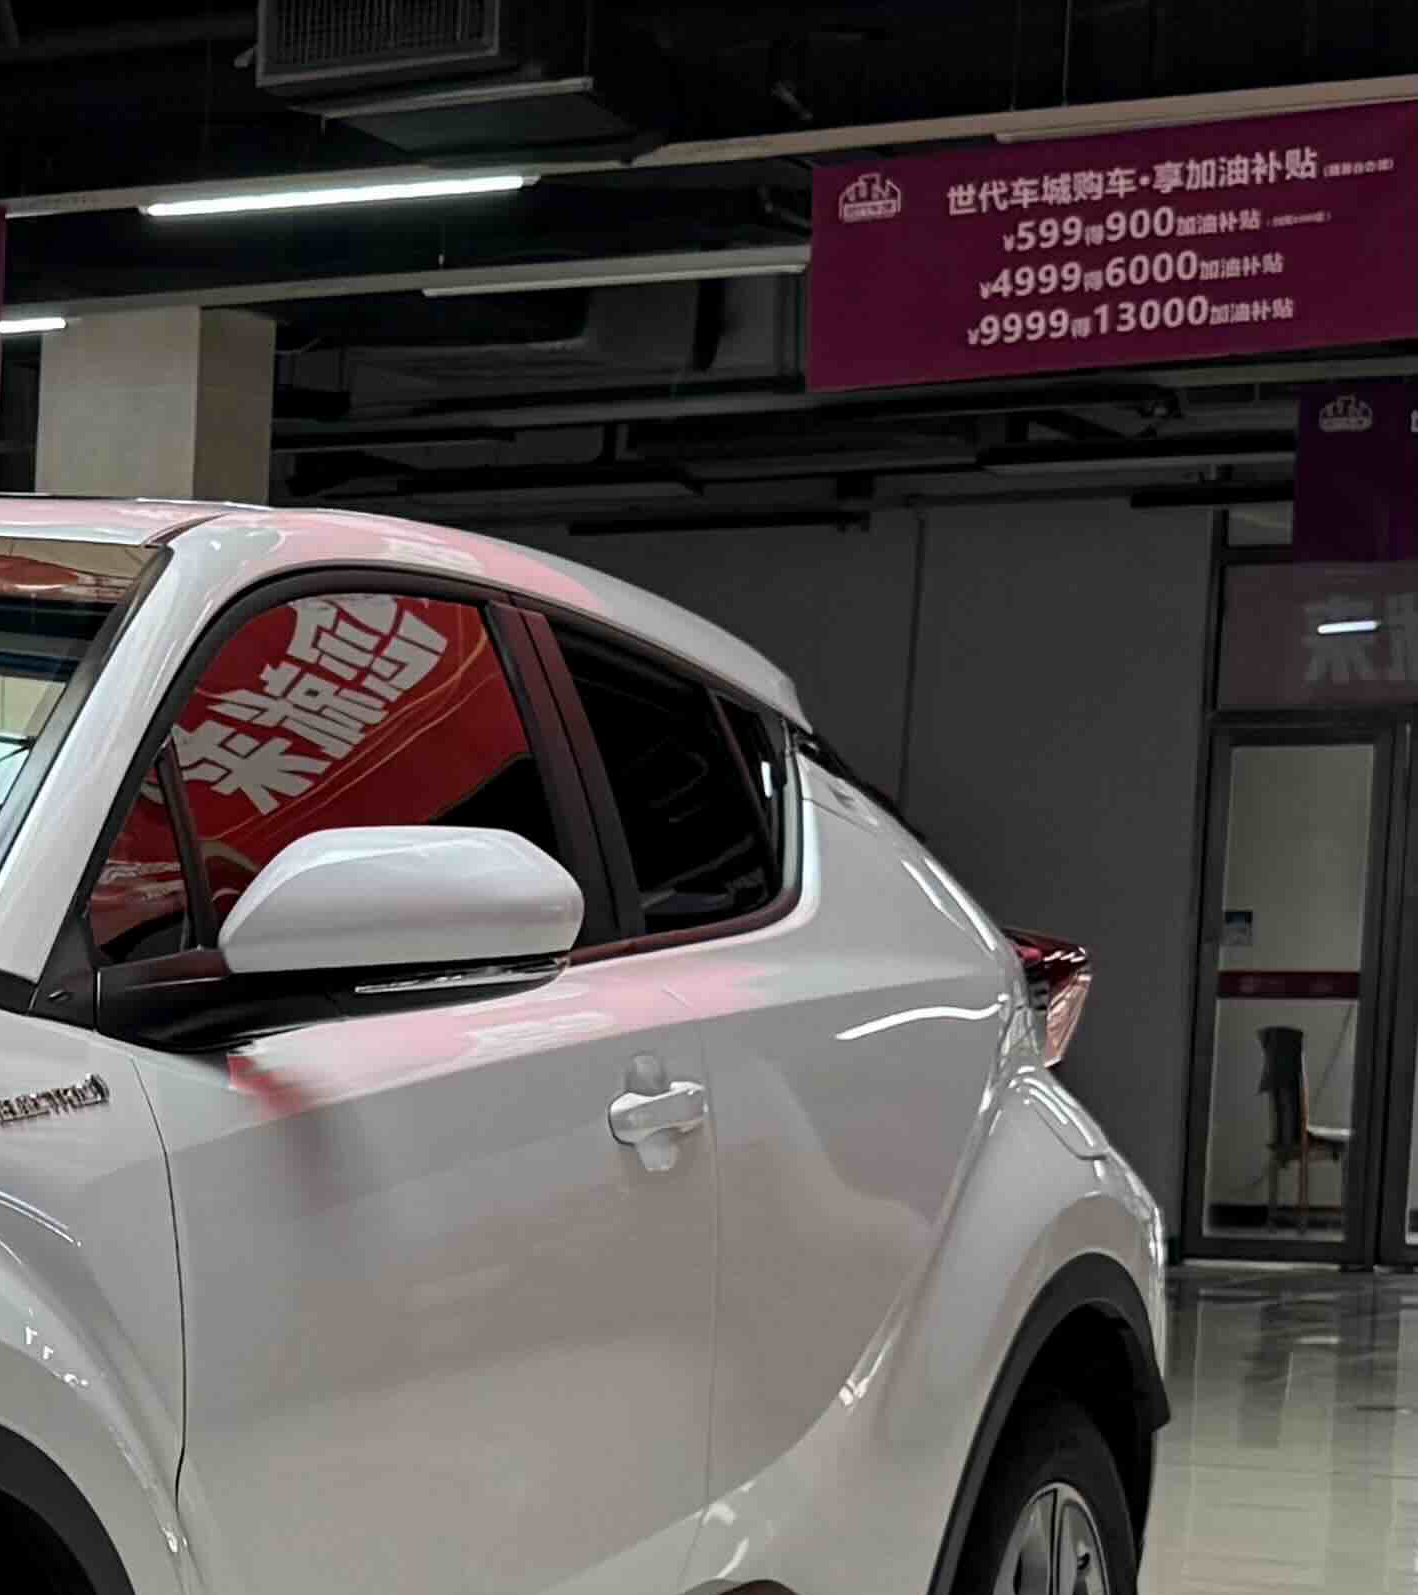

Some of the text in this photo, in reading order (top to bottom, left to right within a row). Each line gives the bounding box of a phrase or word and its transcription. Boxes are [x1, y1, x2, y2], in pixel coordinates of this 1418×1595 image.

[947, 147, 1319, 215] 世代车城购车·享加油补贴
